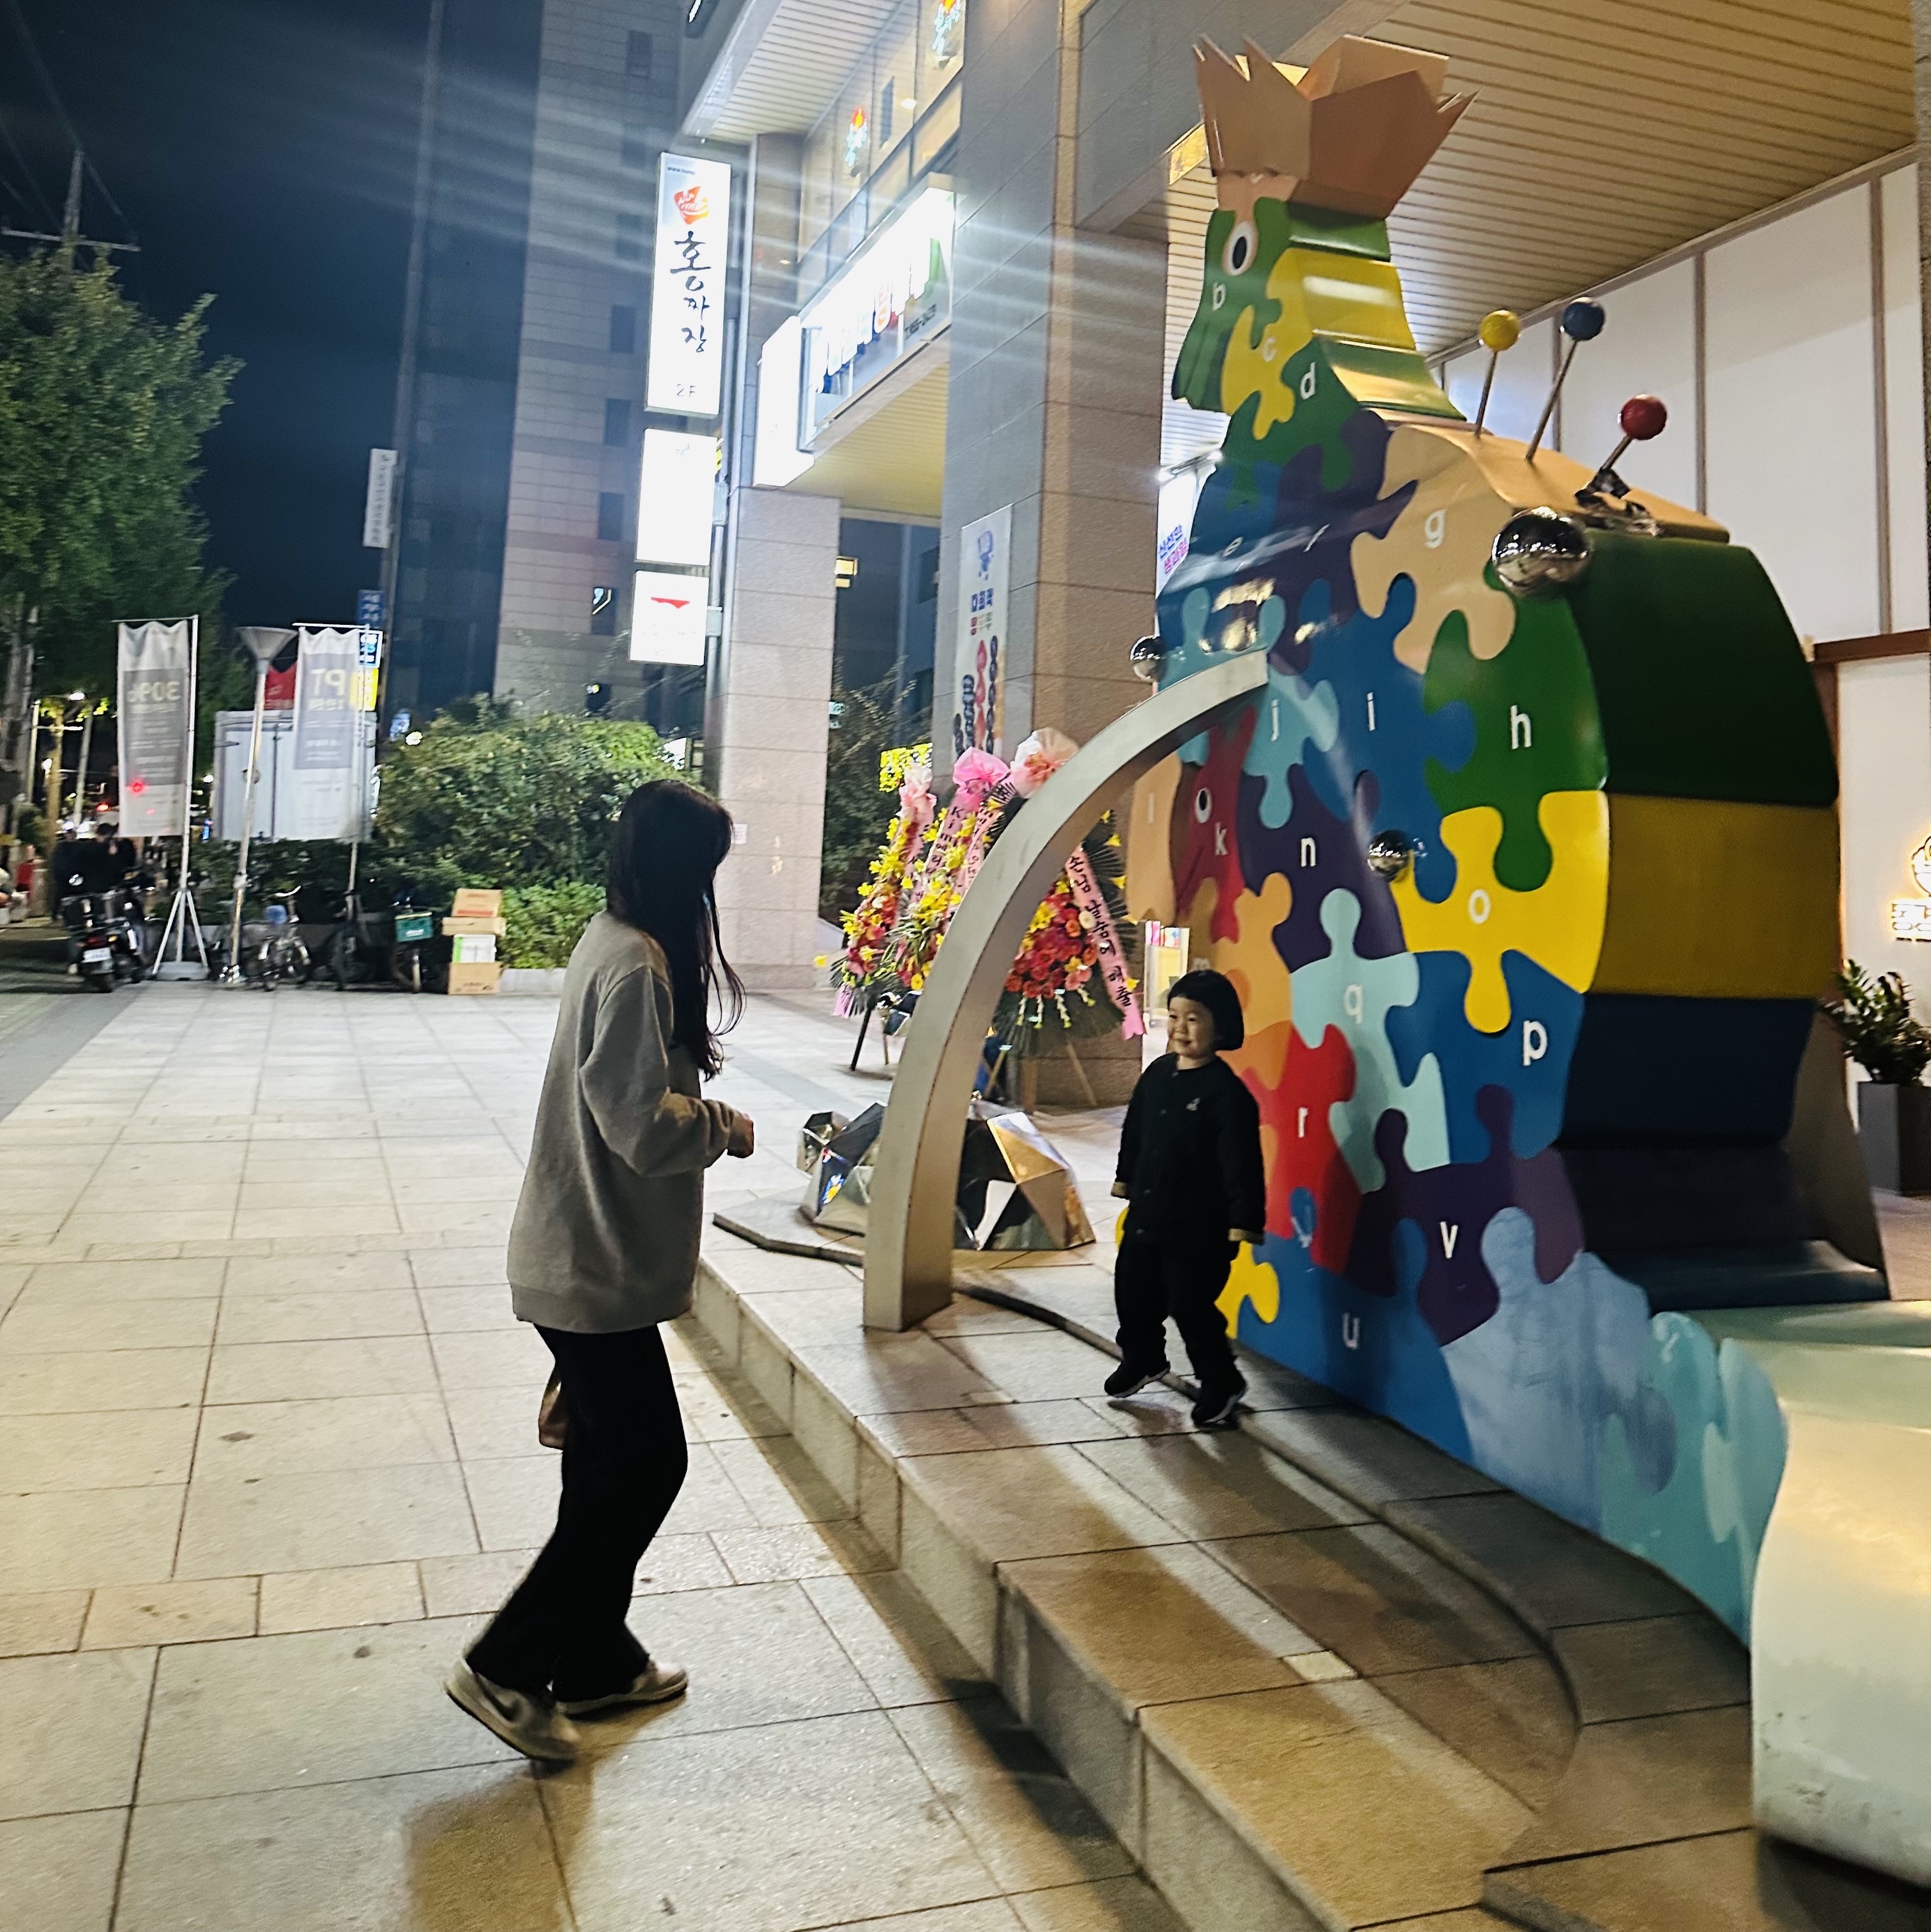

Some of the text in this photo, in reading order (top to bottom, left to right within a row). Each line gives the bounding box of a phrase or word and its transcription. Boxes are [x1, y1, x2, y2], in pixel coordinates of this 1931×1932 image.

[670, 231, 710, 353] 홍짜장
[676, 383, 696, 397] 2F
[1300, 362, 1316, 400] d
[1221, 537, 1244, 558] e
[1424, 509, 1446, 548] g
[1271, 700, 1279, 742] j
[1510, 705, 1532, 749] h
[1215, 822, 1228, 856] k
[1301, 836, 1317, 868] n
[1469, 889, 1492, 924] o
[1345, 985, 1362, 1023] q
[1523, 1020, 1548, 1066] p
[1298, 1107, 1308, 1138] r
[1440, 1221, 1458, 1259] v
[1343, 1312, 1360, 1349] u
